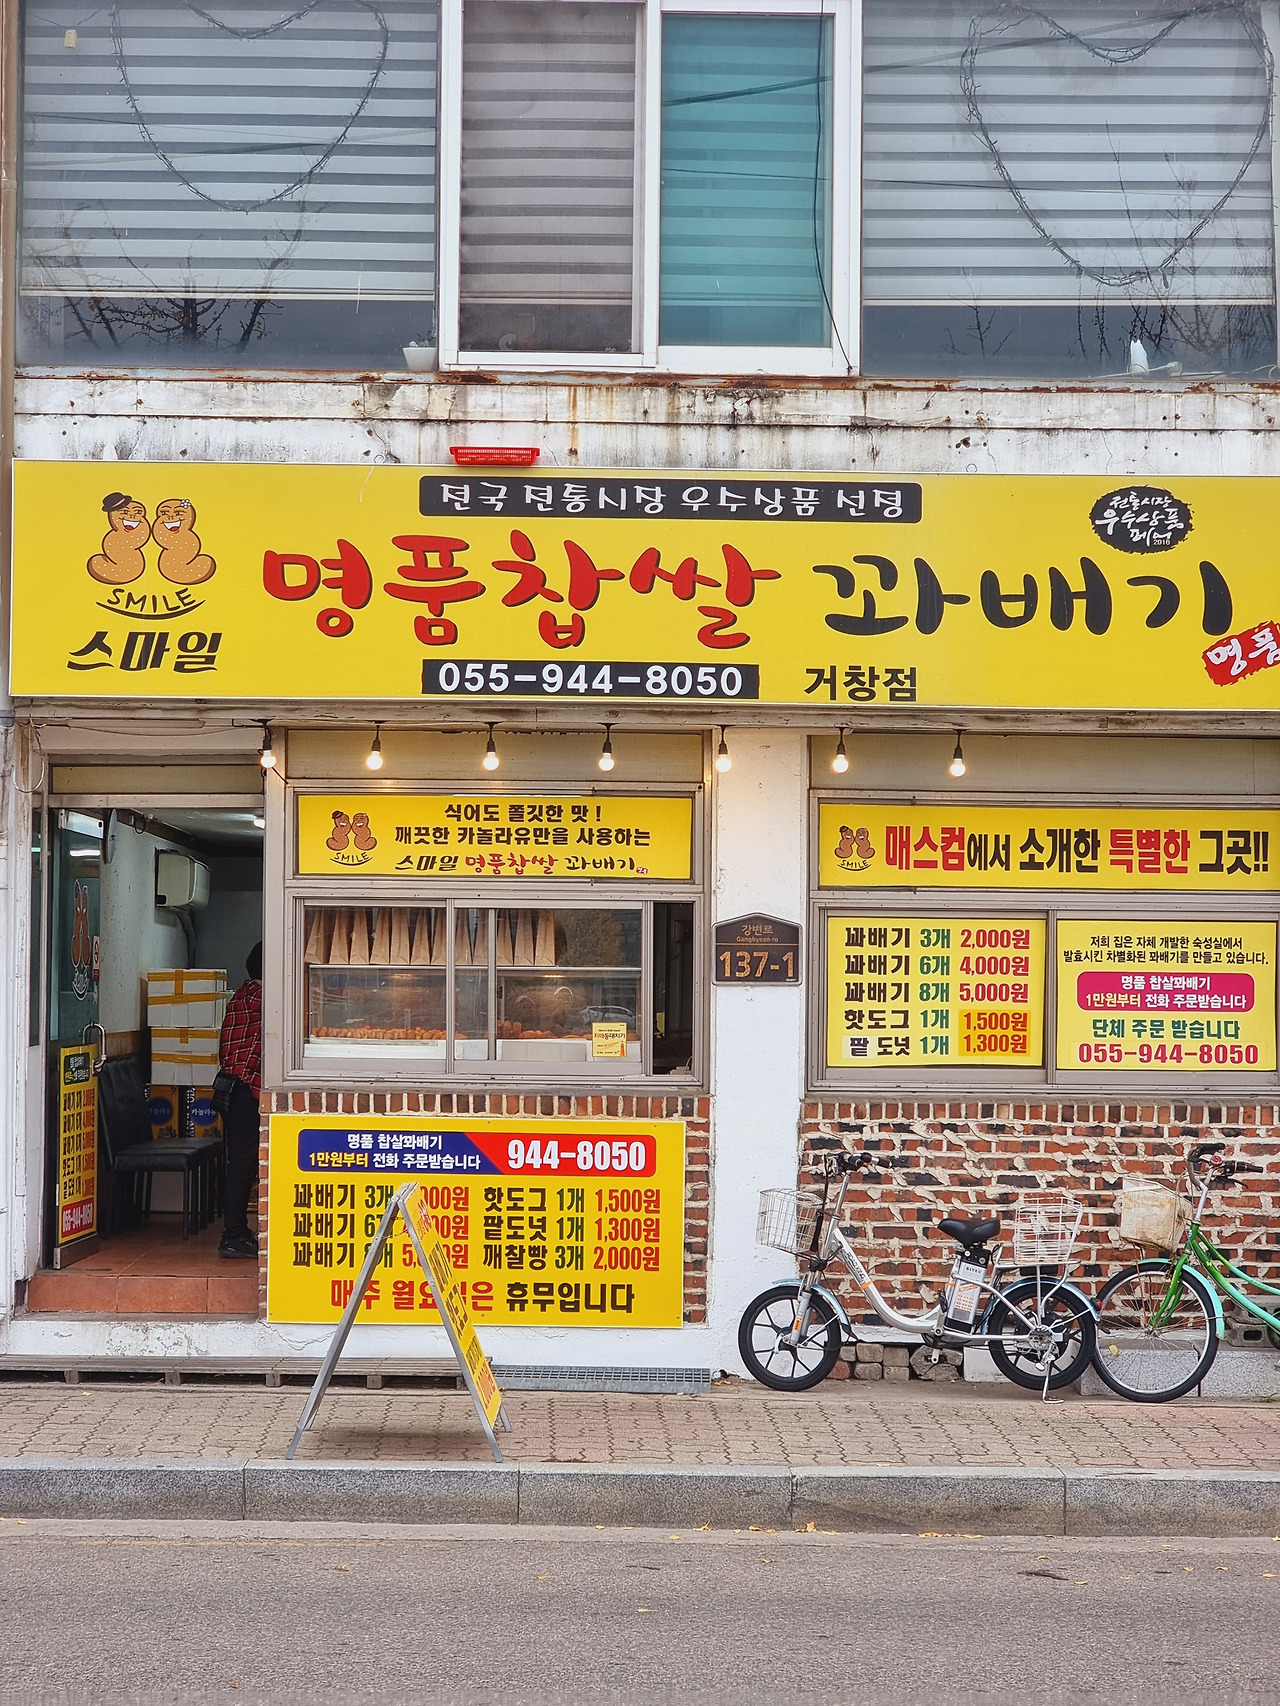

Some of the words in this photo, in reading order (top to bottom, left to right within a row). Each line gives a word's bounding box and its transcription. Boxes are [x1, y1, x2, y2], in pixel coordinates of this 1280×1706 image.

[523, 482, 667, 515] 전통시장
[680, 485, 821, 517] 우수상품
[836, 488, 903, 518] 선정
[1109, 491, 1173, 511] 전통시장
[1095, 508, 1185, 536] 우수상품
[106, 587, 197, 614] SMILE
[811, 554, 1234, 637] 꽈배기
[66, 630, 223, 674] 스마일
[1206, 627, 1280, 676] 명품
[438, 661, 744, 697] 055-944-8050
[803, 665, 918, 702] 거창점
[444, 804, 500, 822] 식어도
[508, 804, 564, 823] 쫄깃한
[394, 826, 450, 845] 깨끗한
[457, 827, 569, 846] 카놀라유만을
[576, 827, 651, 847] 사용하는
[333, 851, 370, 863] SMILE
[885, 825, 1011, 872] 매스컴에서
[1019, 828, 1101, 874] 소개한
[1108, 829, 1190, 874] 특별한
[1198, 830, 1270, 876] 그곳!!
[394, 855, 460, 872] 스마일
[564, 855, 636, 871] 꽈배기
[840, 859, 869, 869] SMILE
[741, 924, 774, 937] 강변로
[844, 927, 911, 948] 꽈배기
[919, 928, 951, 949] 3개
[960, 929, 1031, 950] 2,000원
[1090, 936, 1110, 948] 저희
[1113, 936, 1134, 948] 집은
[1136, 936, 1156, 949] 자체
[1159, 937, 1190, 949] 개발한
[1192, 937, 1243, 950] 숙성실에서
[719, 951, 795, 978] 137-1
[844, 954, 911, 976] 꽈배기
[919, 955, 950, 976] 6개
[959, 956, 1030, 977] 4,000원
[1063, 949, 1103, 963] 발효시킨
[1106, 950, 1146, 963] 차별화된
[1149, 950, 1190, 964] 꽈배기를
[1192, 951, 1223, 964] 만들고
[1225, 951, 1269, 965] 있습니다.
[844, 982, 910, 1003] 꽈배기
[918, 982, 950, 1003] 8개
[959, 983, 1029, 1004] 5,000원
[1121, 975, 1146, 991] 명품
[1149, 975, 1211, 991] 찹살꽈배기
[1085, 992, 1141, 1007] 1만원부터
[1144, 993, 1170, 1009] 전화
[1172, 994, 1247, 1009] 주문받습니다
[844, 1009, 910, 1030] 핫도그
[919, 1009, 950, 1029] 1개
[963, 1012, 1028, 1032] 1,500원
[1092, 1018, 1125, 1038] 단체
[1131, 1019, 1165, 1039] 주문
[1171, 1019, 1241, 1040] 받습니다
[849, 1037, 870, 1057] 팥
[877, 1036, 911, 1057] 도넛
[919, 1036, 950, 1055] 1개
[963, 1034, 1028, 1055] 1,300원
[1078, 1043, 1260, 1065] 055-944-8050
[347, 1133, 374, 1150] 명품
[377, 1134, 443, 1150] 찹살꽈배기
[309, 1152, 369, 1168] 1만원부터
[372, 1152, 399, 1169] 전화
[402, 1153, 481, 1170] 주문받습니다
[506, 1139, 646, 1172] 944-8050
[293, 1183, 355, 1211] 꽈배기
[364, 1185, 394, 1210] 3개
[483, 1186, 547, 1213] 핫도그
[556, 1187, 585, 1213] 1개
[594, 1188, 661, 1215] 1,500원
[293, 1213, 355, 1240] 꽈배기
[483, 1216, 547, 1242] 팥도넛
[556, 1216, 584, 1242] 1개
[594, 1217, 661, 1243] 1,300원
[292, 1242, 355, 1268] 꽈배기
[482, 1243, 547, 1270] 깨찰빵
[555, 1245, 584, 1271] 3개
[593, 1246, 660, 1272] 2,000원
[331, 1280, 381, 1310] 매주
[506, 1281, 635, 1314] 휴무입니다
